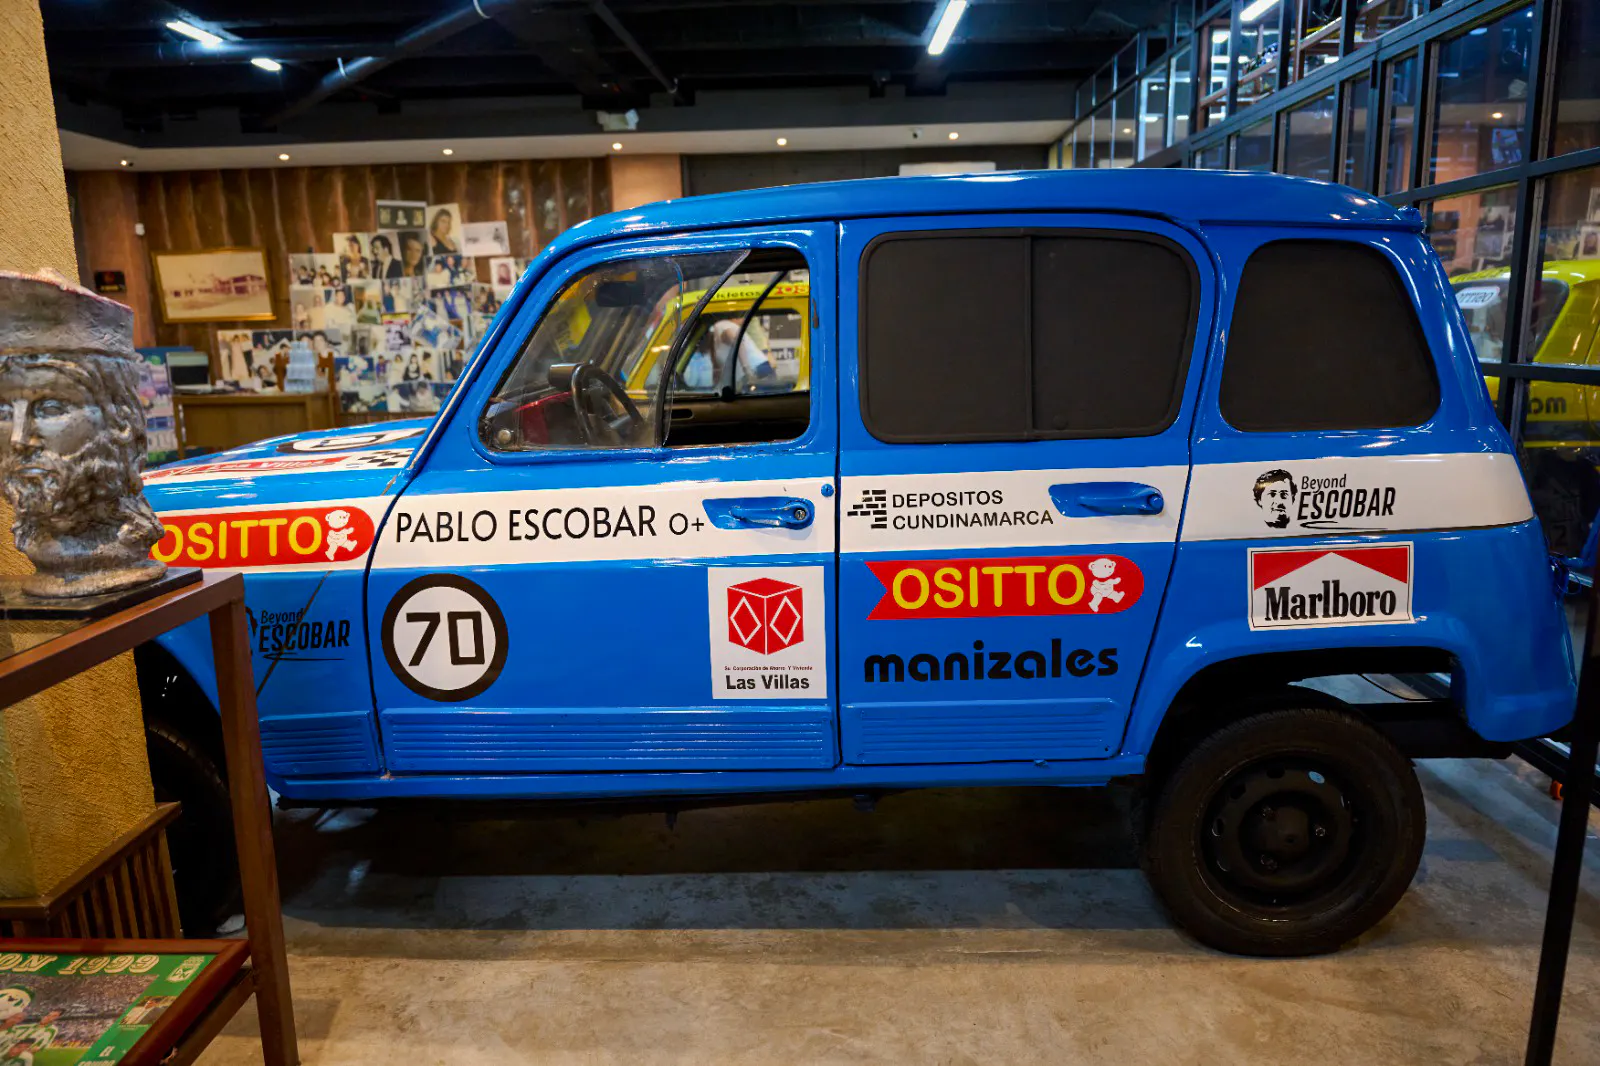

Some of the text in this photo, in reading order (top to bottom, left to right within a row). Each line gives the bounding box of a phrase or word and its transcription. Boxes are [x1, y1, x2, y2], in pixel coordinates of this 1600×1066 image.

[892, 490, 1003, 508] DEPOSITOS
[1301, 474, 1347, 494] Beyond
[1297, 487, 1396, 520] ESCOBAR
[396, 510, 498, 543] PABLO
[509, 505, 657, 540] ESCOBAR
[892, 510, 1053, 530] CUNDINAMARCA
[151, 515, 322, 563] OSITTO
[892, 563, 1086, 610] OSITTO
[1265, 580, 1396, 621] Marlboro
[260, 607, 305, 624] Beyond
[259, 620, 350, 652] ESCOBAR
[406, 611, 486, 667] 70
[864, 638, 1119, 683] manizales
[725, 674, 810, 690] Las Villas
[0, 953, 58, 972] ON
[58, 955, 159, 975] 1999
